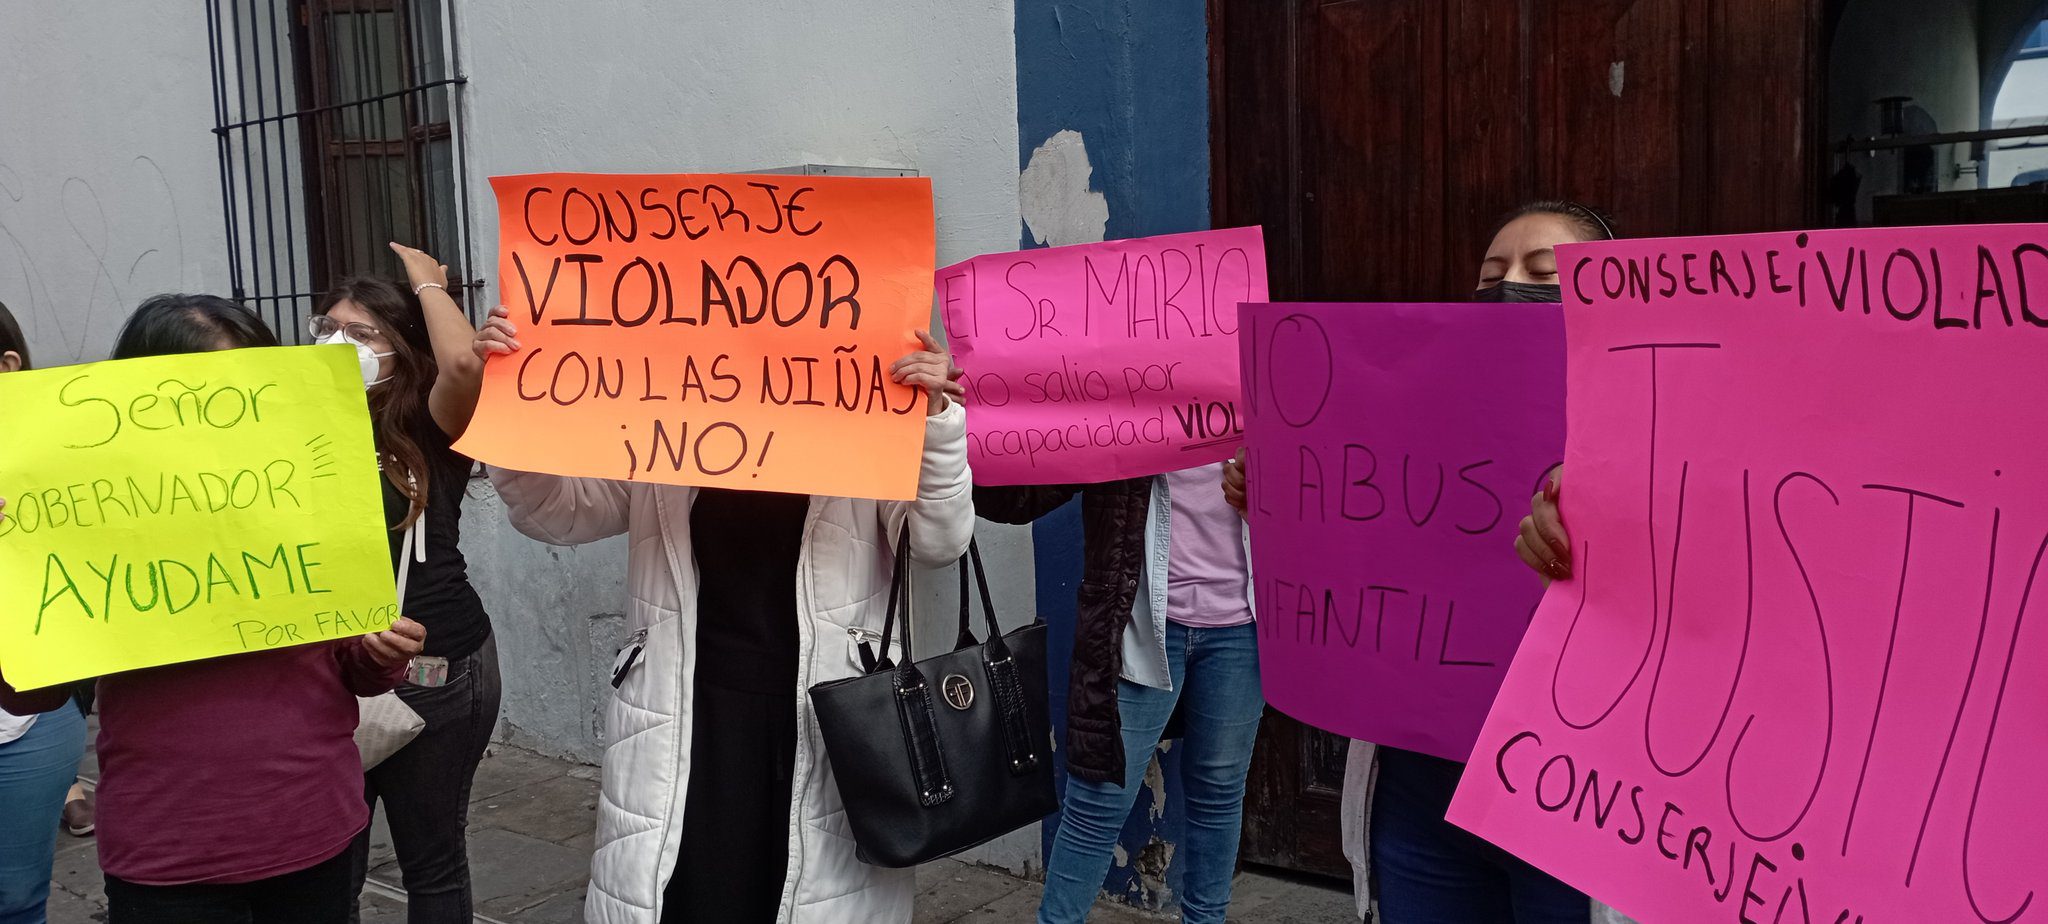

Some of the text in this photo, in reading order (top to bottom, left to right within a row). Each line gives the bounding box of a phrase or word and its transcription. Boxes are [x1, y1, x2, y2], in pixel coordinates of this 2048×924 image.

[523, 181, 824, 247] CONSERJE
[511, 253, 861, 331] VIOLADOR
[944, 261, 979, 340] El
[1084, 243, 1251, 340] MARIO
[58, 374, 278, 449] Señor
[516, 347, 623, 407] CON
[640, 353, 742, 403] LAS
[1023, 354, 1110, 405] salio
[1122, 360, 1183, 408] por
[620, 418, 775, 481] ¡NO!
[1298, 443, 1565, 536] ABUS
[33, 541, 333, 636] AYUDAME
[314, 603, 399, 636] FAVOR
